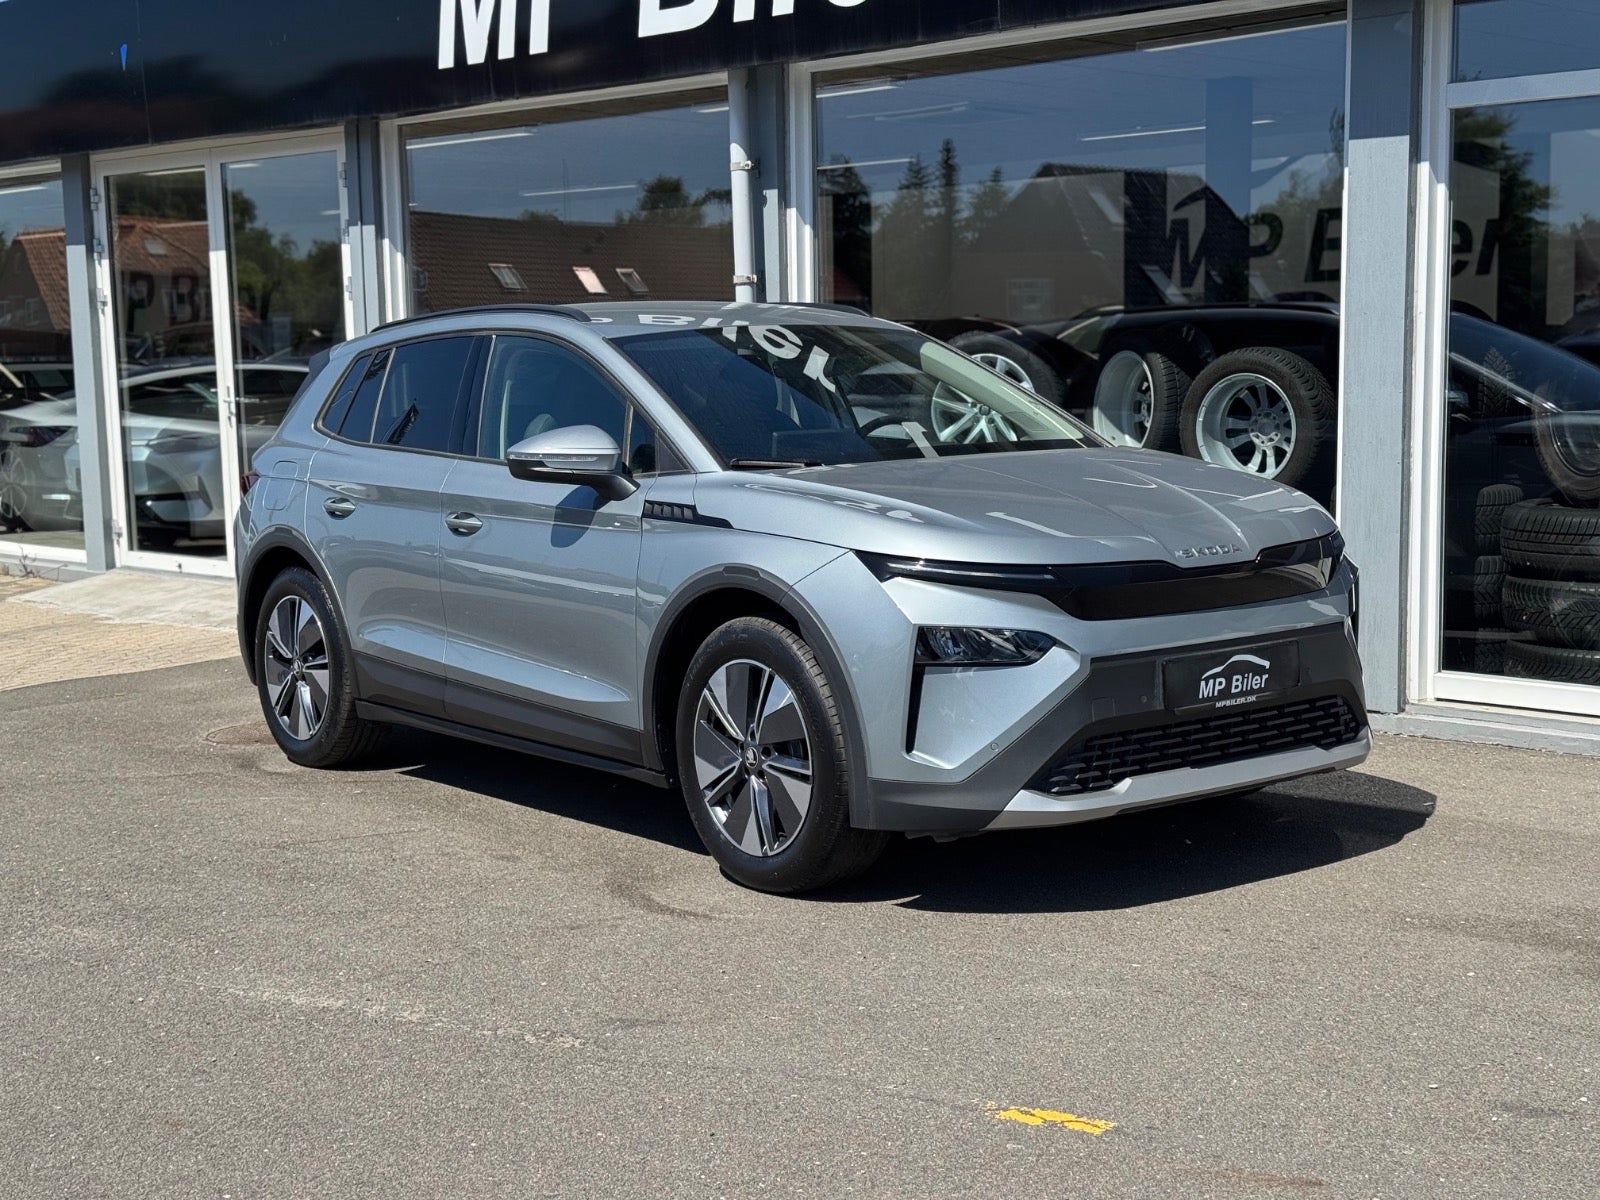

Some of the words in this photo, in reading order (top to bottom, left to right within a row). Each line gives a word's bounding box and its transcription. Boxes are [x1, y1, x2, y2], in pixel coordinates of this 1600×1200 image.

[1199, 677, 1226, 699] MP
[1231, 672, 1269, 694] Biler
[1215, 694, 1257, 708] MPBILER.DK
